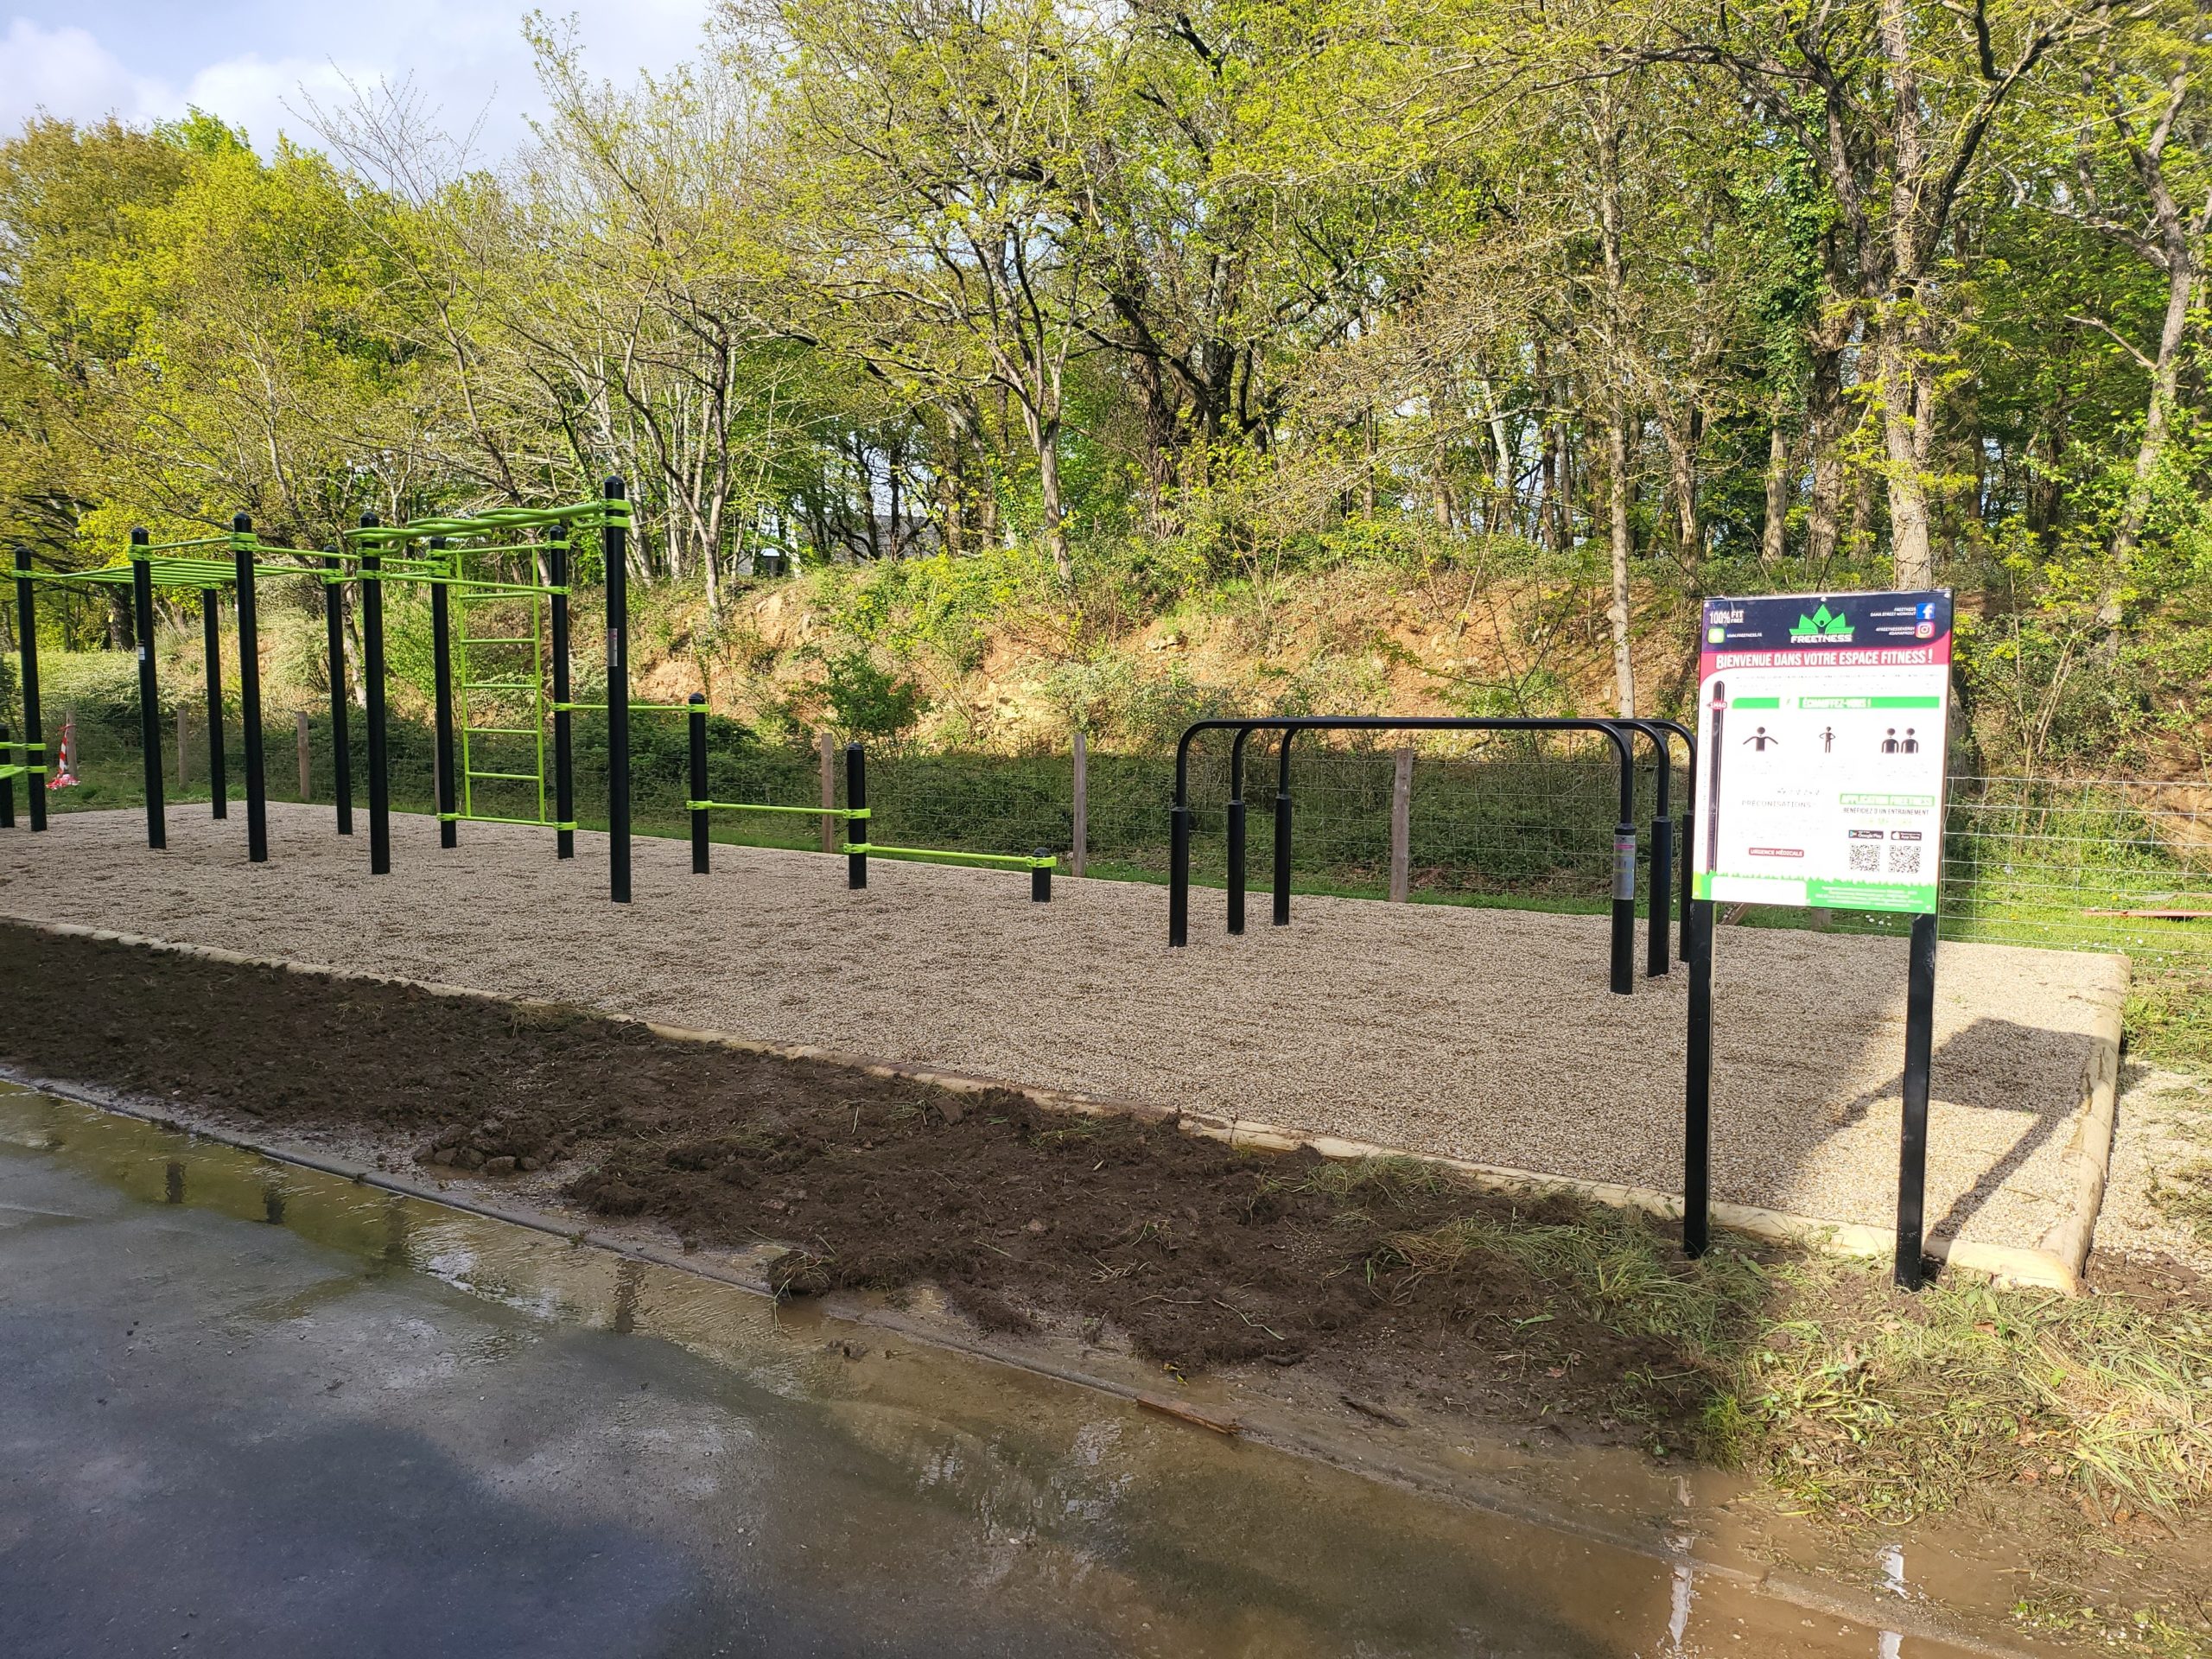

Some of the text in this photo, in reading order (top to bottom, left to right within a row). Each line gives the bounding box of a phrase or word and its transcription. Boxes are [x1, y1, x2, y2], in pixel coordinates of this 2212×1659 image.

[1709, 609, 1744, 624] 100% FIT
[1790, 634, 1853, 644] FREETNESS
[1716, 649, 1933, 670] BIENVENUE DANS VOTRE ESPACE FITNESS !
